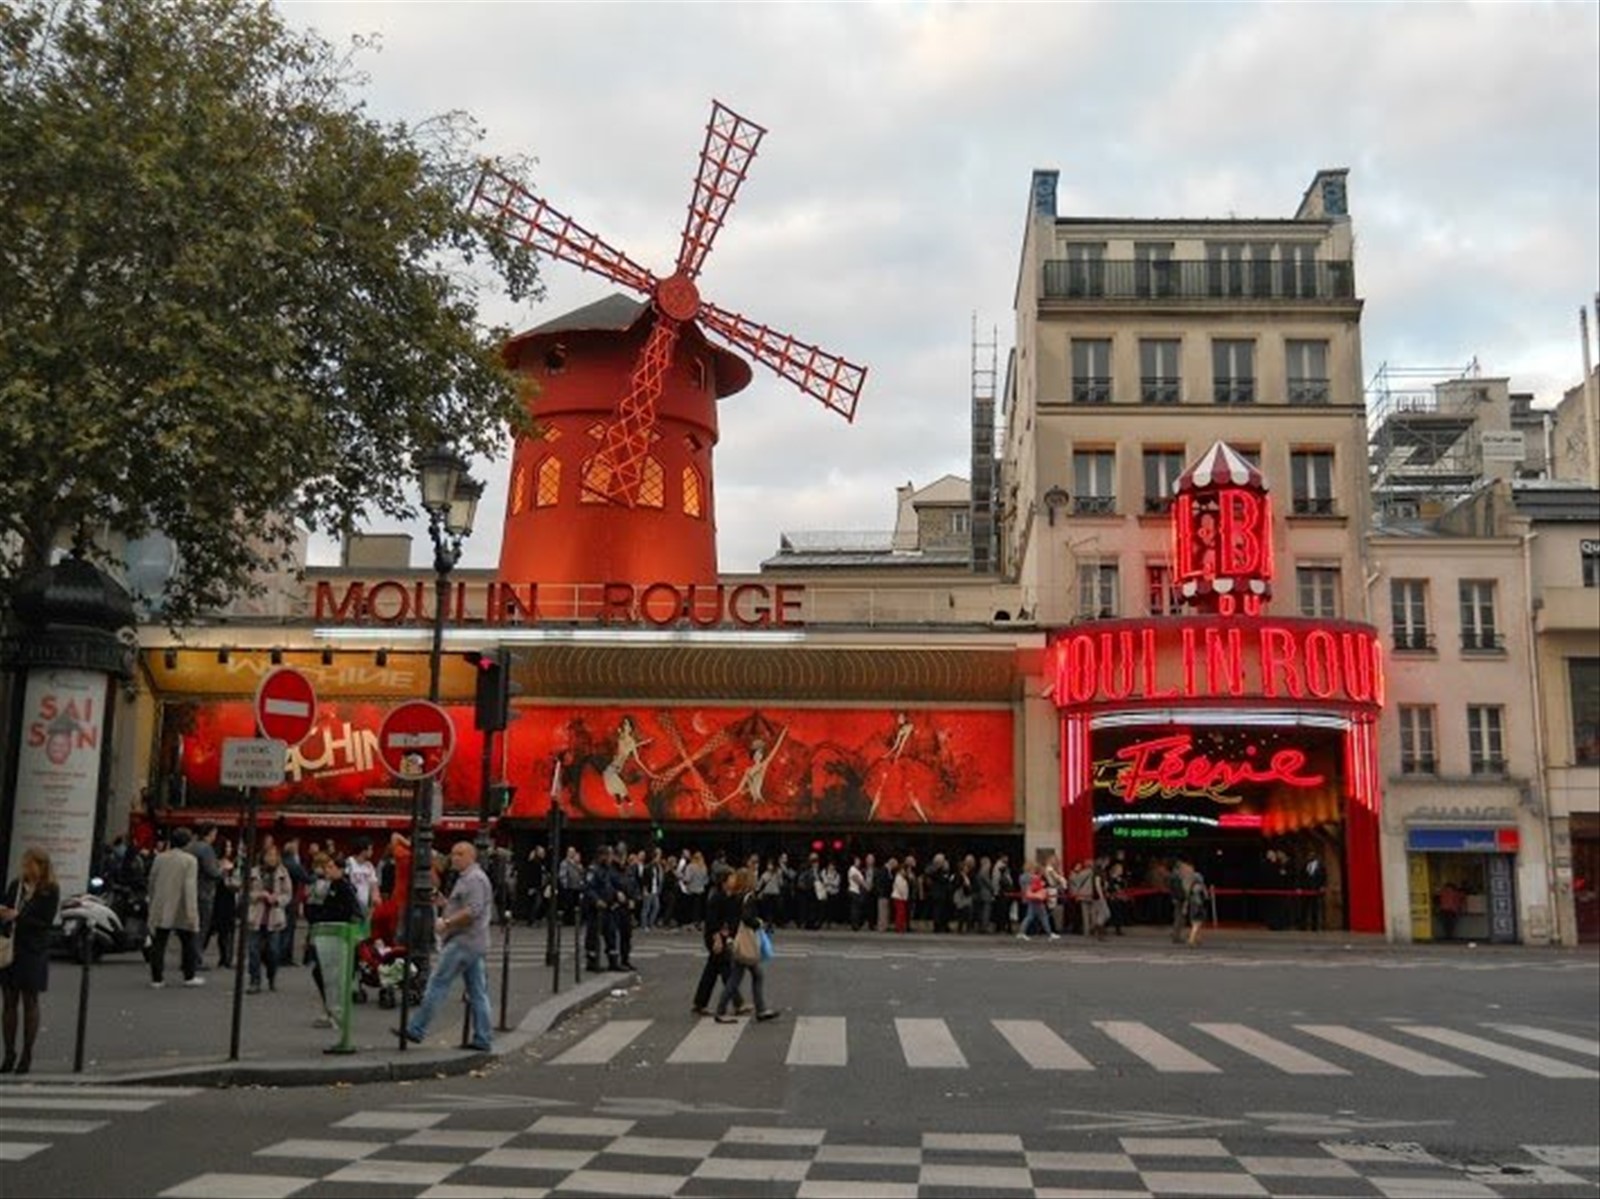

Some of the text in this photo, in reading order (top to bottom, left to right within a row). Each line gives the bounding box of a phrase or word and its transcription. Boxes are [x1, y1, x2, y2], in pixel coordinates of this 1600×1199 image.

[1219, 489, 1259, 576] B
[314, 581, 806, 626] MOULIN ROUGE
[40, 695, 93, 721] SAI
[27, 721, 97, 750] SN
